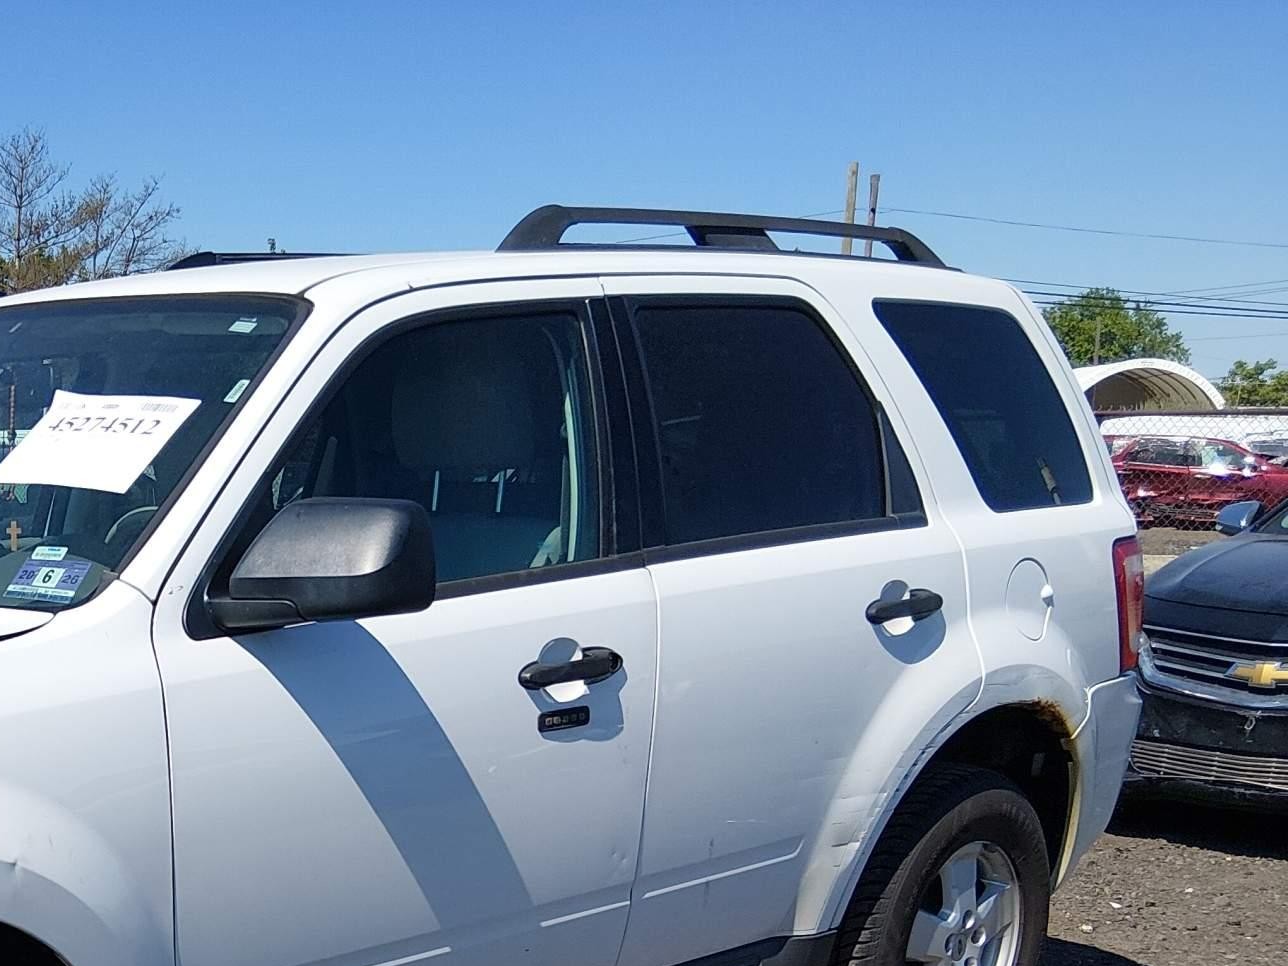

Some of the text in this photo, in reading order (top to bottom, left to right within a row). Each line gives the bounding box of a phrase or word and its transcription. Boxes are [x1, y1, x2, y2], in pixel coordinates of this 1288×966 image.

[48, 415, 162, 436] 45274512
[17, 569, 36, 581] 20
[42, 569, 55, 584] 6
